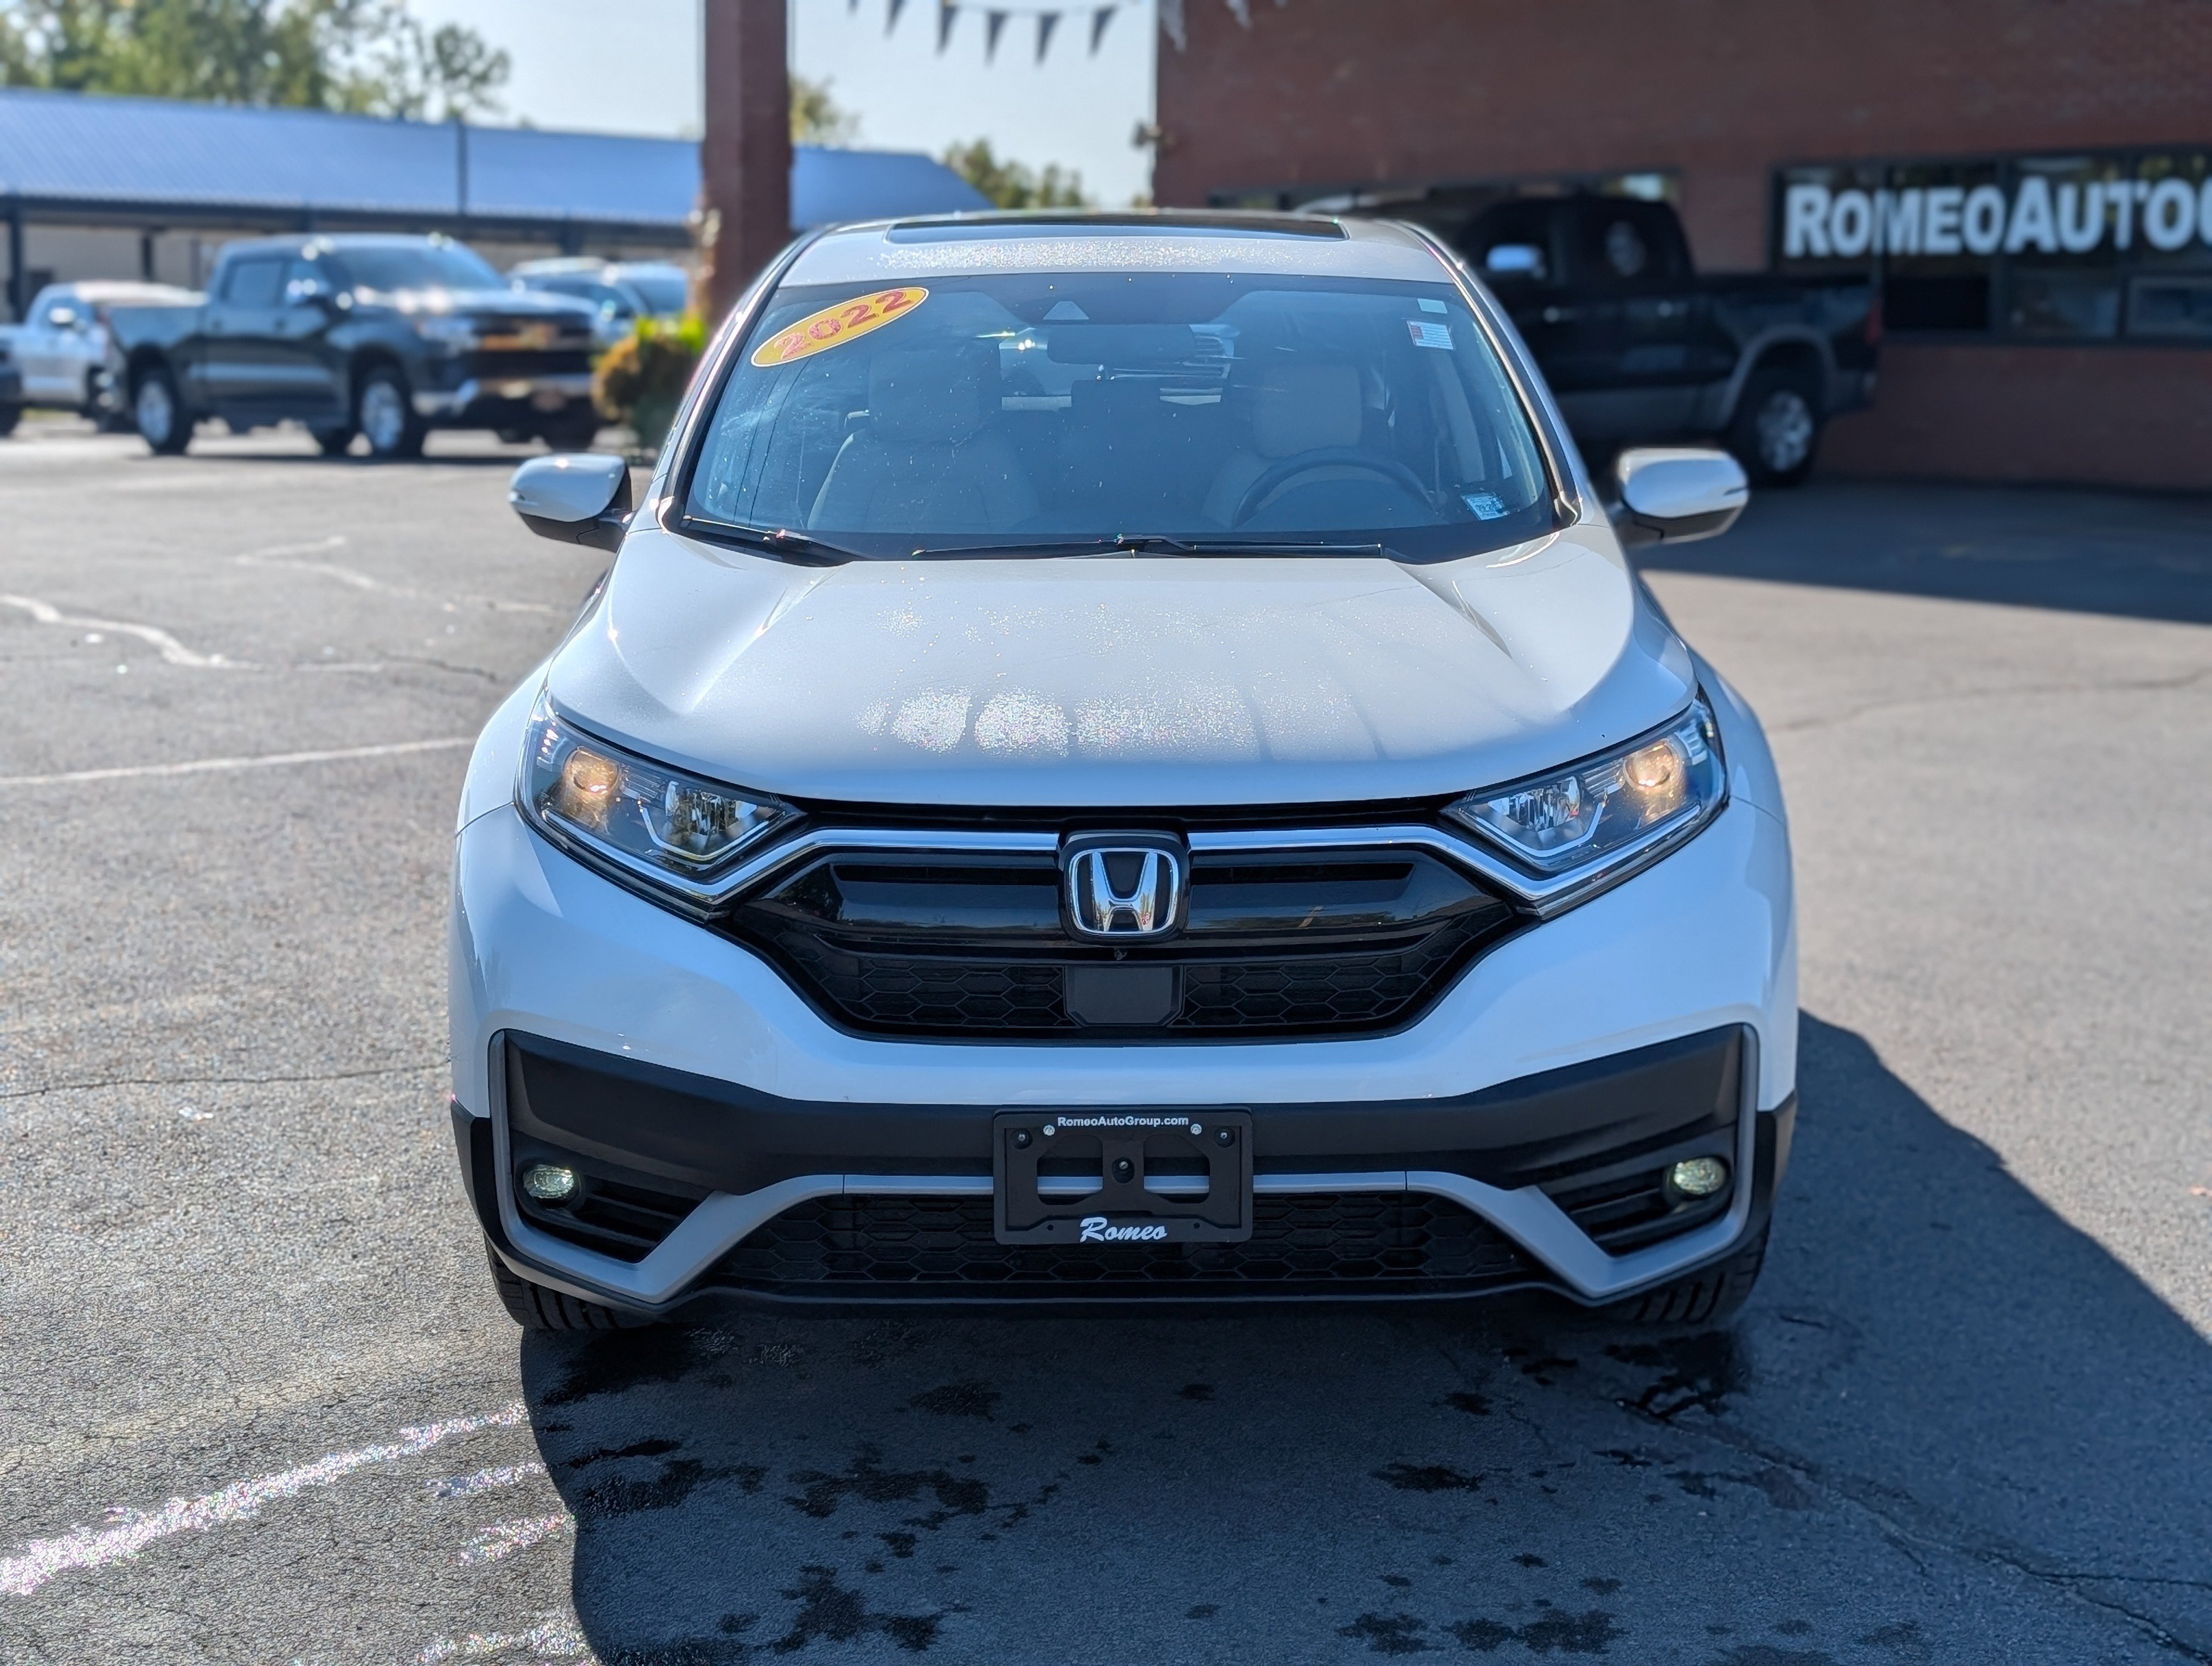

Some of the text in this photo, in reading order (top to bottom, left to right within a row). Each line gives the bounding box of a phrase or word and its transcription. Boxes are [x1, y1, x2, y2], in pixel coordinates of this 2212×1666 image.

[774, 290, 915, 360] 2022
[1057, 1116, 1189, 1127] RomeoAutoGroup.com
[1079, 1216, 1168, 1242] Romeo
